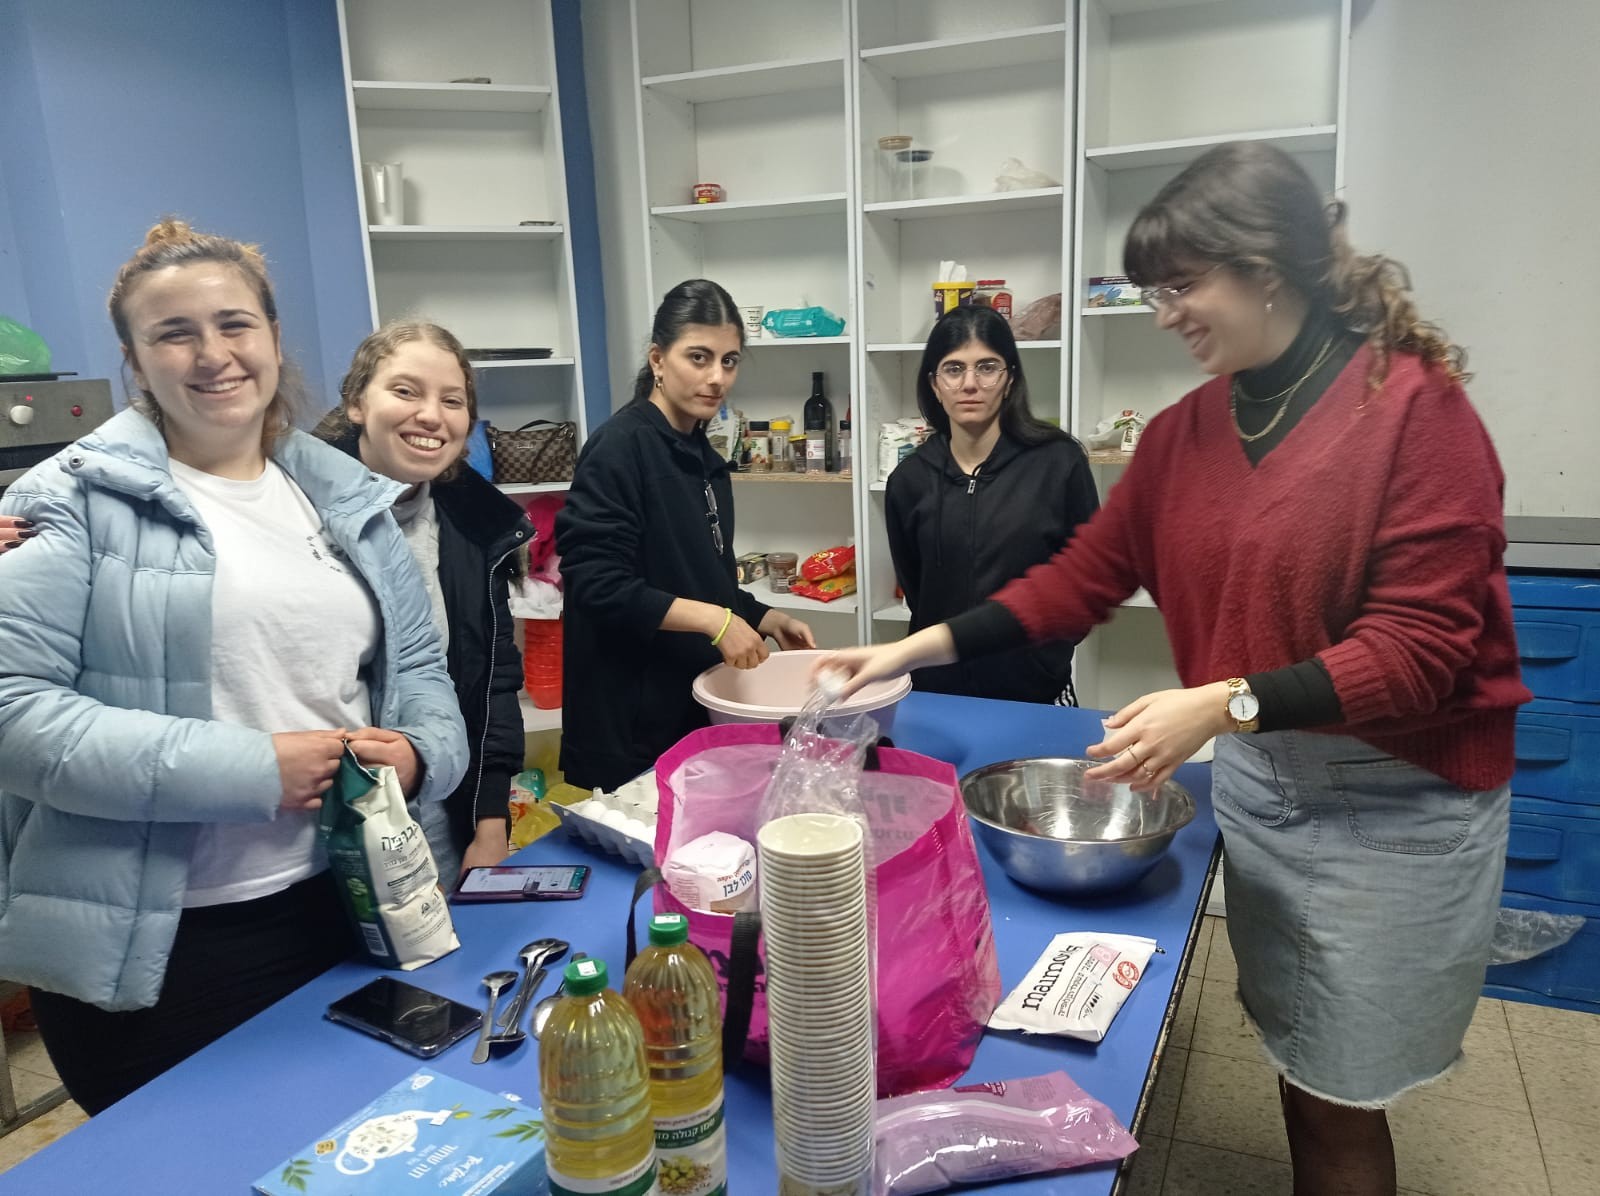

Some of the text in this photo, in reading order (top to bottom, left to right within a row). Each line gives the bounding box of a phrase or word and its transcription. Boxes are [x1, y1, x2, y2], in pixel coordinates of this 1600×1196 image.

[723, 880, 740, 897] לבן
[700, 1117, 716, 1133] שמן
[672, 1127, 699, 1140] קנולה
[408, 1165, 431, 1179] תה
[430, 1144, 459, 1166] שחור
